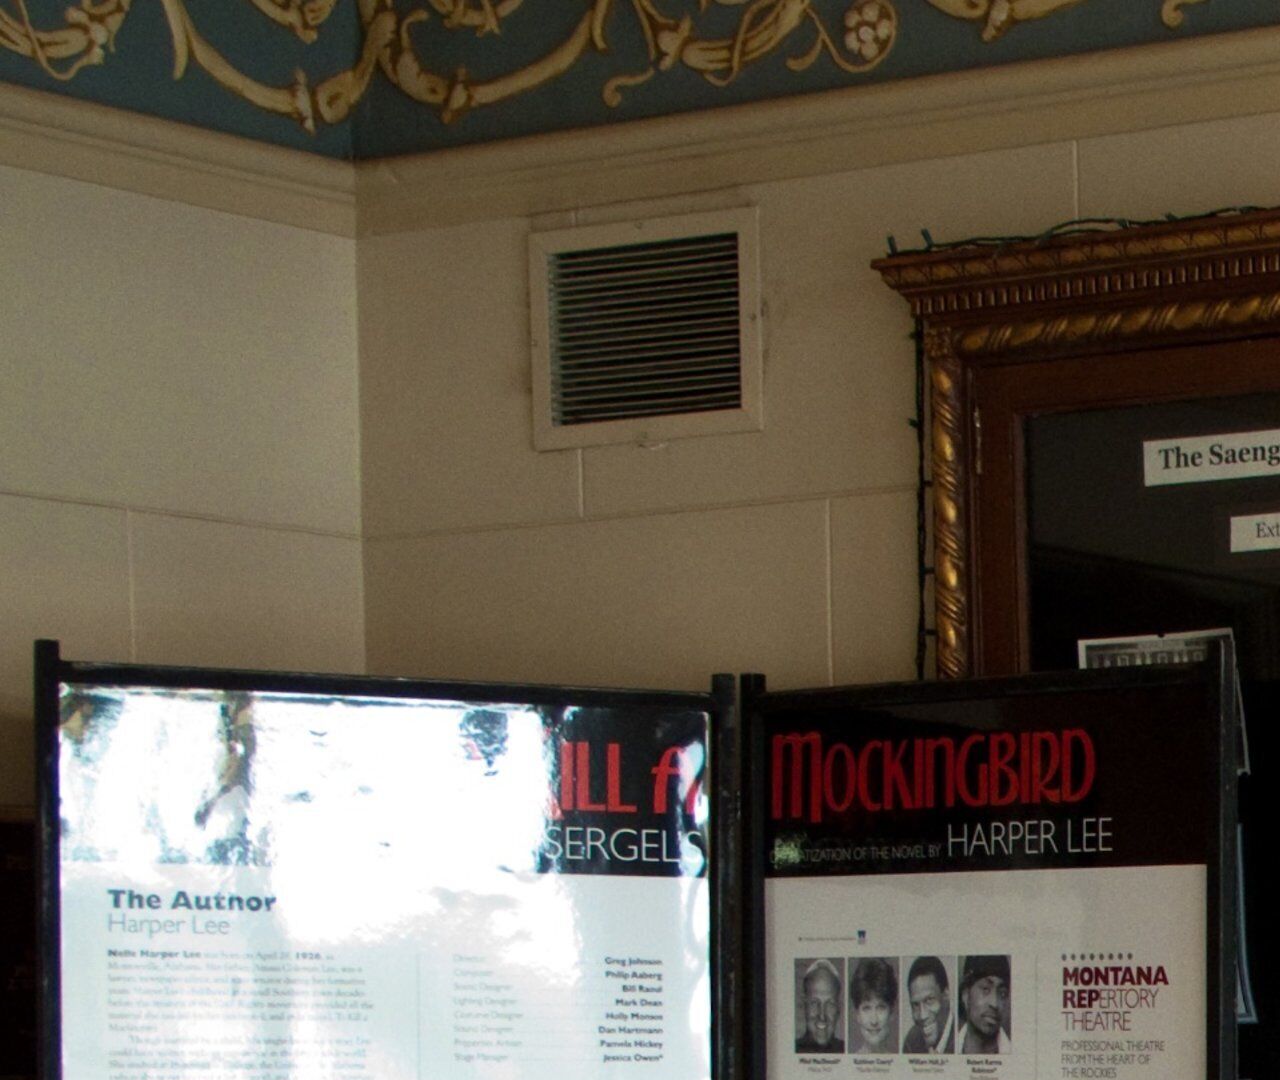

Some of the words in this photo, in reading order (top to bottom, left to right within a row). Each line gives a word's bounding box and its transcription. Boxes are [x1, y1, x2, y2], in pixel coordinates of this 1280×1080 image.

[1158, 446, 1203, 471] The
[549, 740, 638, 820] ILL
[771, 727, 1097, 824] MOCKINGBIRD
[948, 820, 1059, 858] HARPER
[1067, 817, 1113, 854] LEE
[108, 888, 163, 911] The
[108, 913, 187, 940] Harper
[192, 915, 231, 935] Lee
[605, 957, 626, 967] Greg
[628, 957, 663, 967] Johnson
[1062, 965, 1169, 986] MONTANA
[1062, 988, 1159, 1009] REPERTORY
[1061, 1011, 1132, 1032] THEATRE
[1061, 1040, 1125, 1052] PROFESSIONAL
[1126, 1040, 1165, 1052] THEATRE
[1061, 1053, 1086, 1065] FROM
[1086, 1053, 1105, 1065] THE
[1107, 1053, 1135, 1065] HEART
[1137, 1053, 1152, 1065] OF
[1061, 1067, 1080, 1079] THE
[1080, 1067, 1117, 1079] ROCKIES
